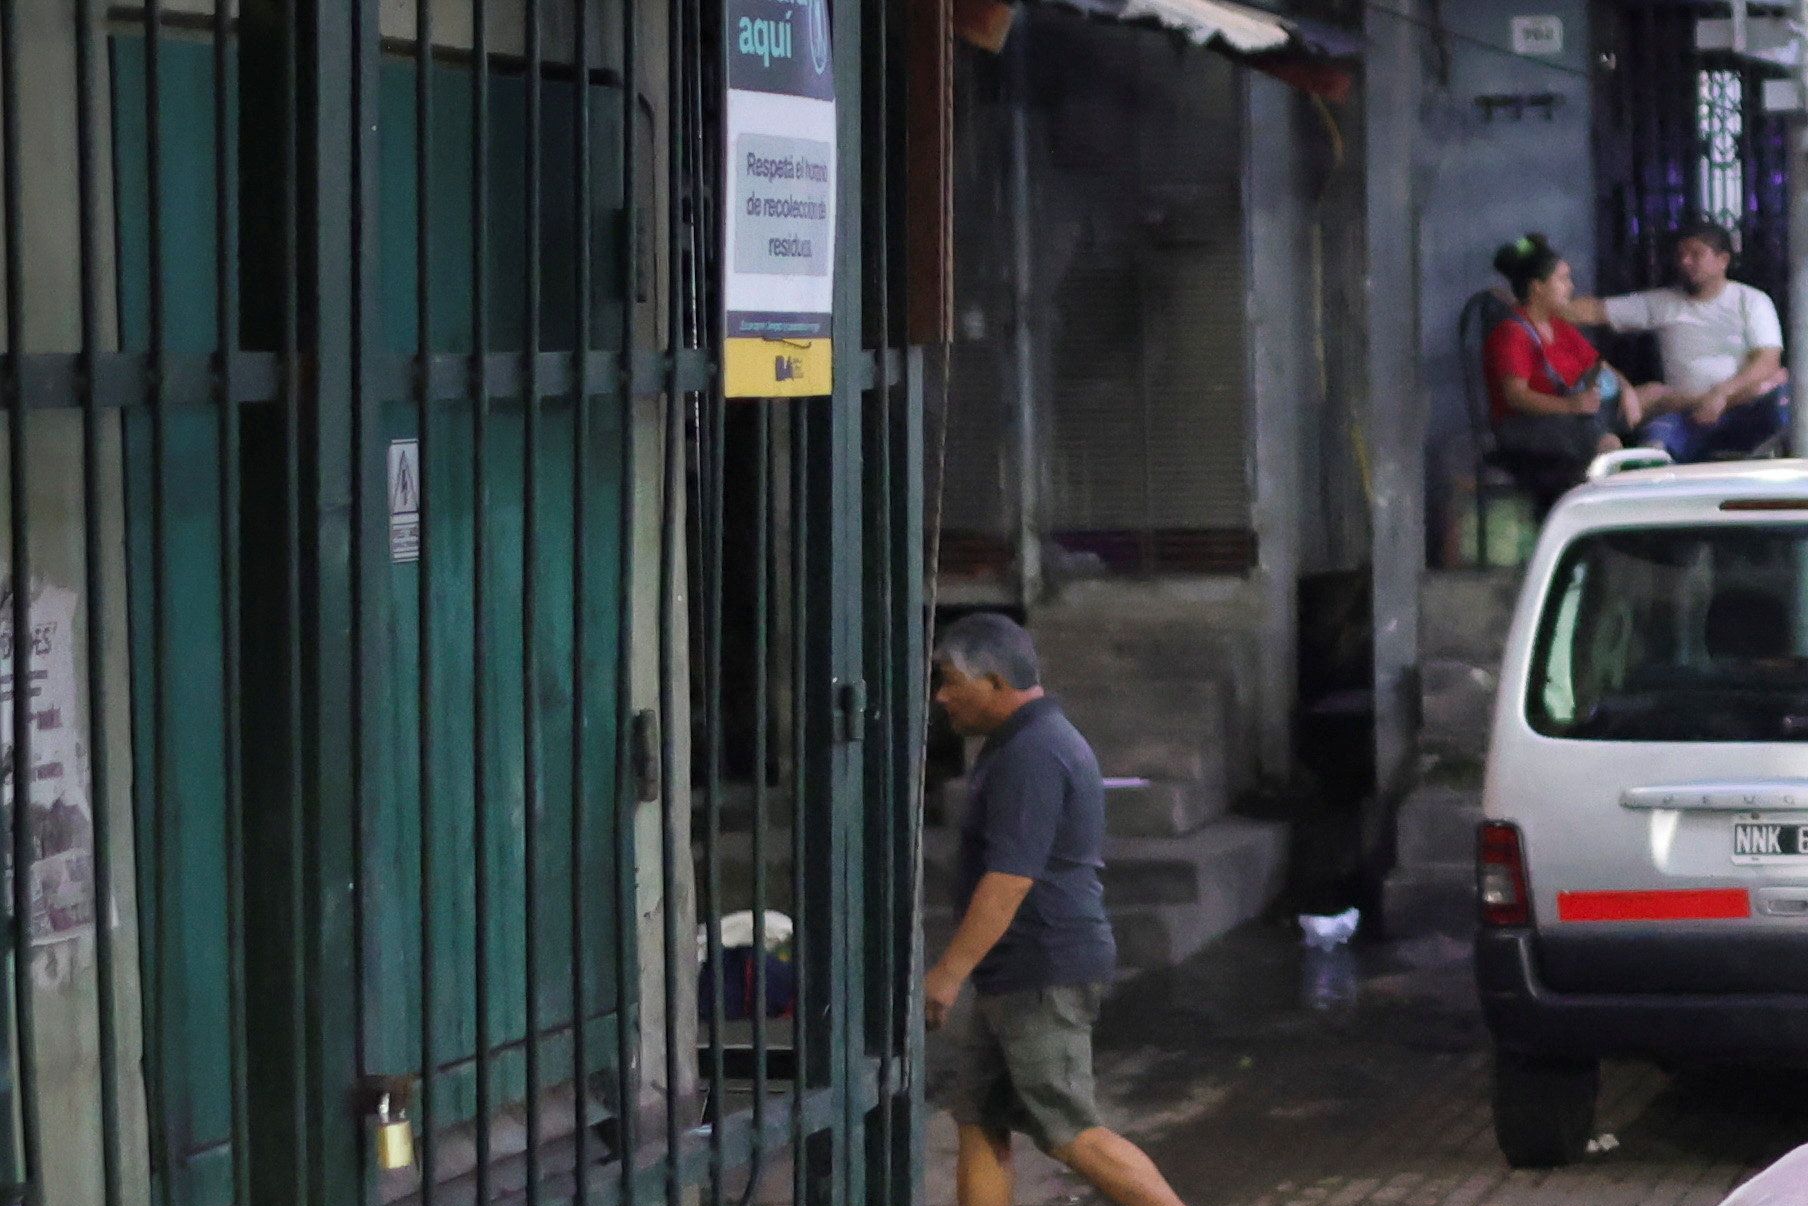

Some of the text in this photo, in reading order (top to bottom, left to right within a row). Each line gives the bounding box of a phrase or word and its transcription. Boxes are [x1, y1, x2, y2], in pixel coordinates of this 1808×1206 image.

[739, 10, 792, 68] aquí
[746, 152, 794, 183] Respetá
[746, 191, 761, 216] de
[1735, 825, 1783, 855] NNK
